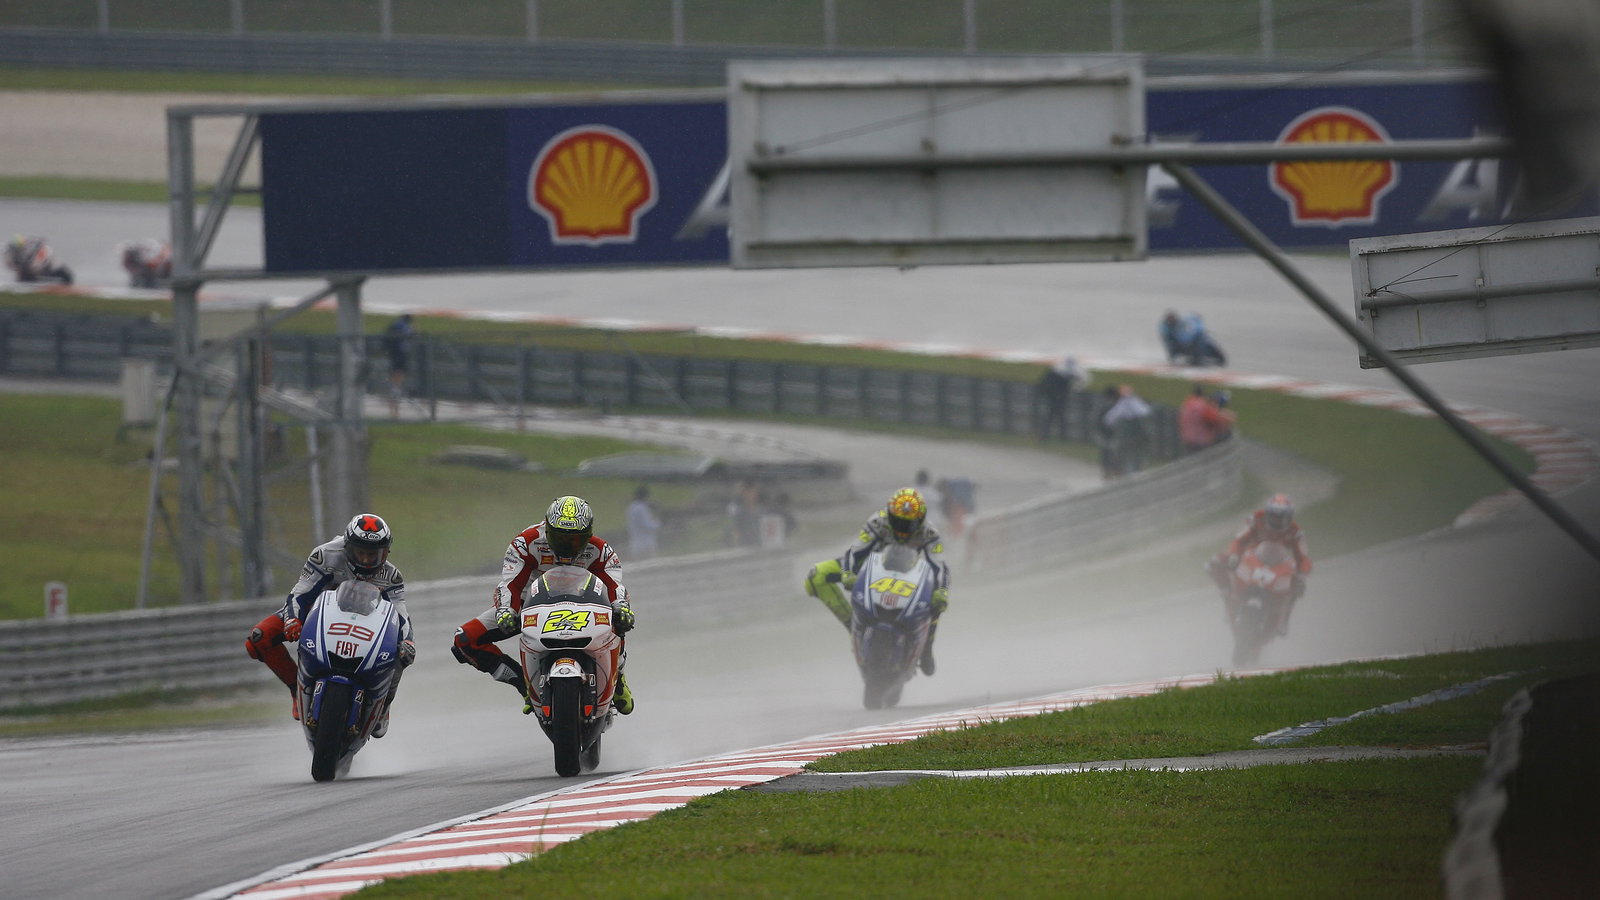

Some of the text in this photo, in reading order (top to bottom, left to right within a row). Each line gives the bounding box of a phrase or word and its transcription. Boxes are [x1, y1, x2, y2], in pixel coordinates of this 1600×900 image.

[868, 577, 918, 598] 46
[49, 588, 65, 616] F
[327, 622, 375, 642] 99
[541, 609, 592, 634] 24
[335, 640, 360, 658] FIAT
